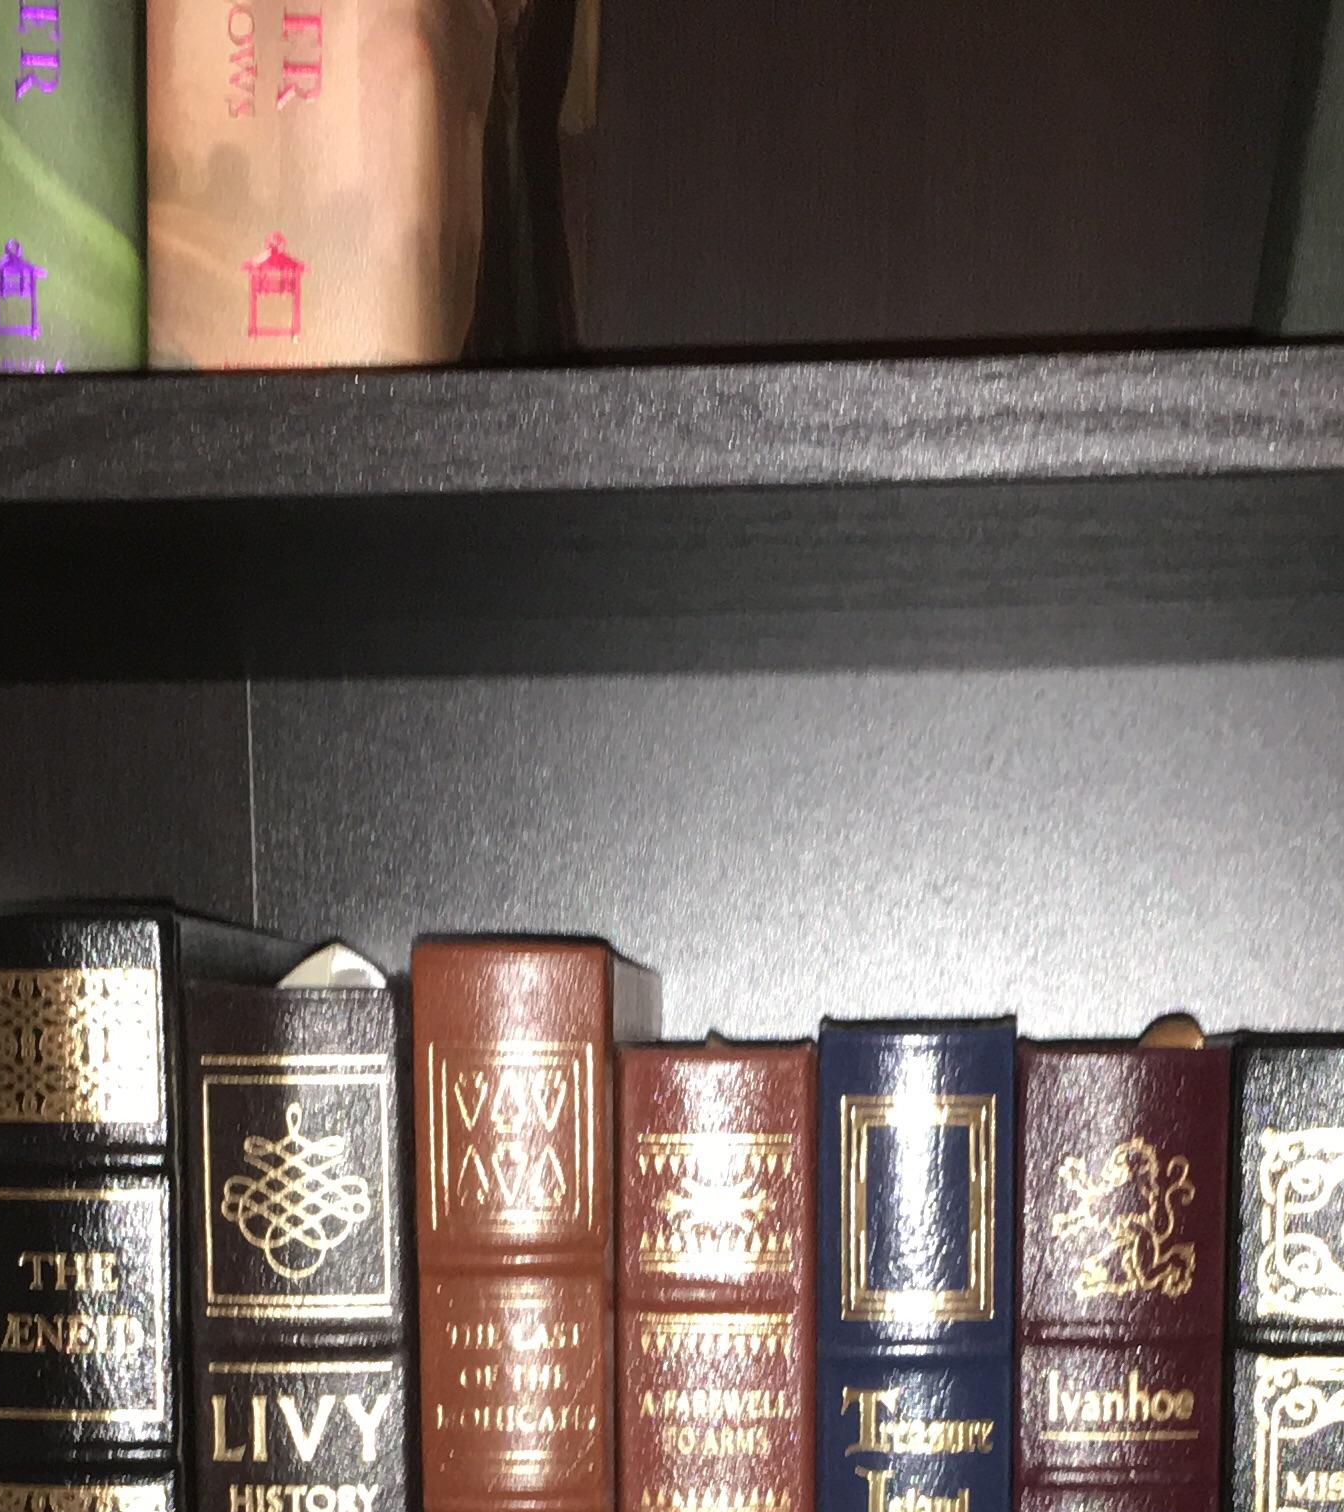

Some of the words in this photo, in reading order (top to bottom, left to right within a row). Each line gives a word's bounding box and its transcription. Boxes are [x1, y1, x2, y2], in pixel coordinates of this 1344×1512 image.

[17, 1251, 119, 1292] THE
[1046, 1369, 1195, 1424] Ivanhoe
[211, 1394, 392, 1462] LIVY
